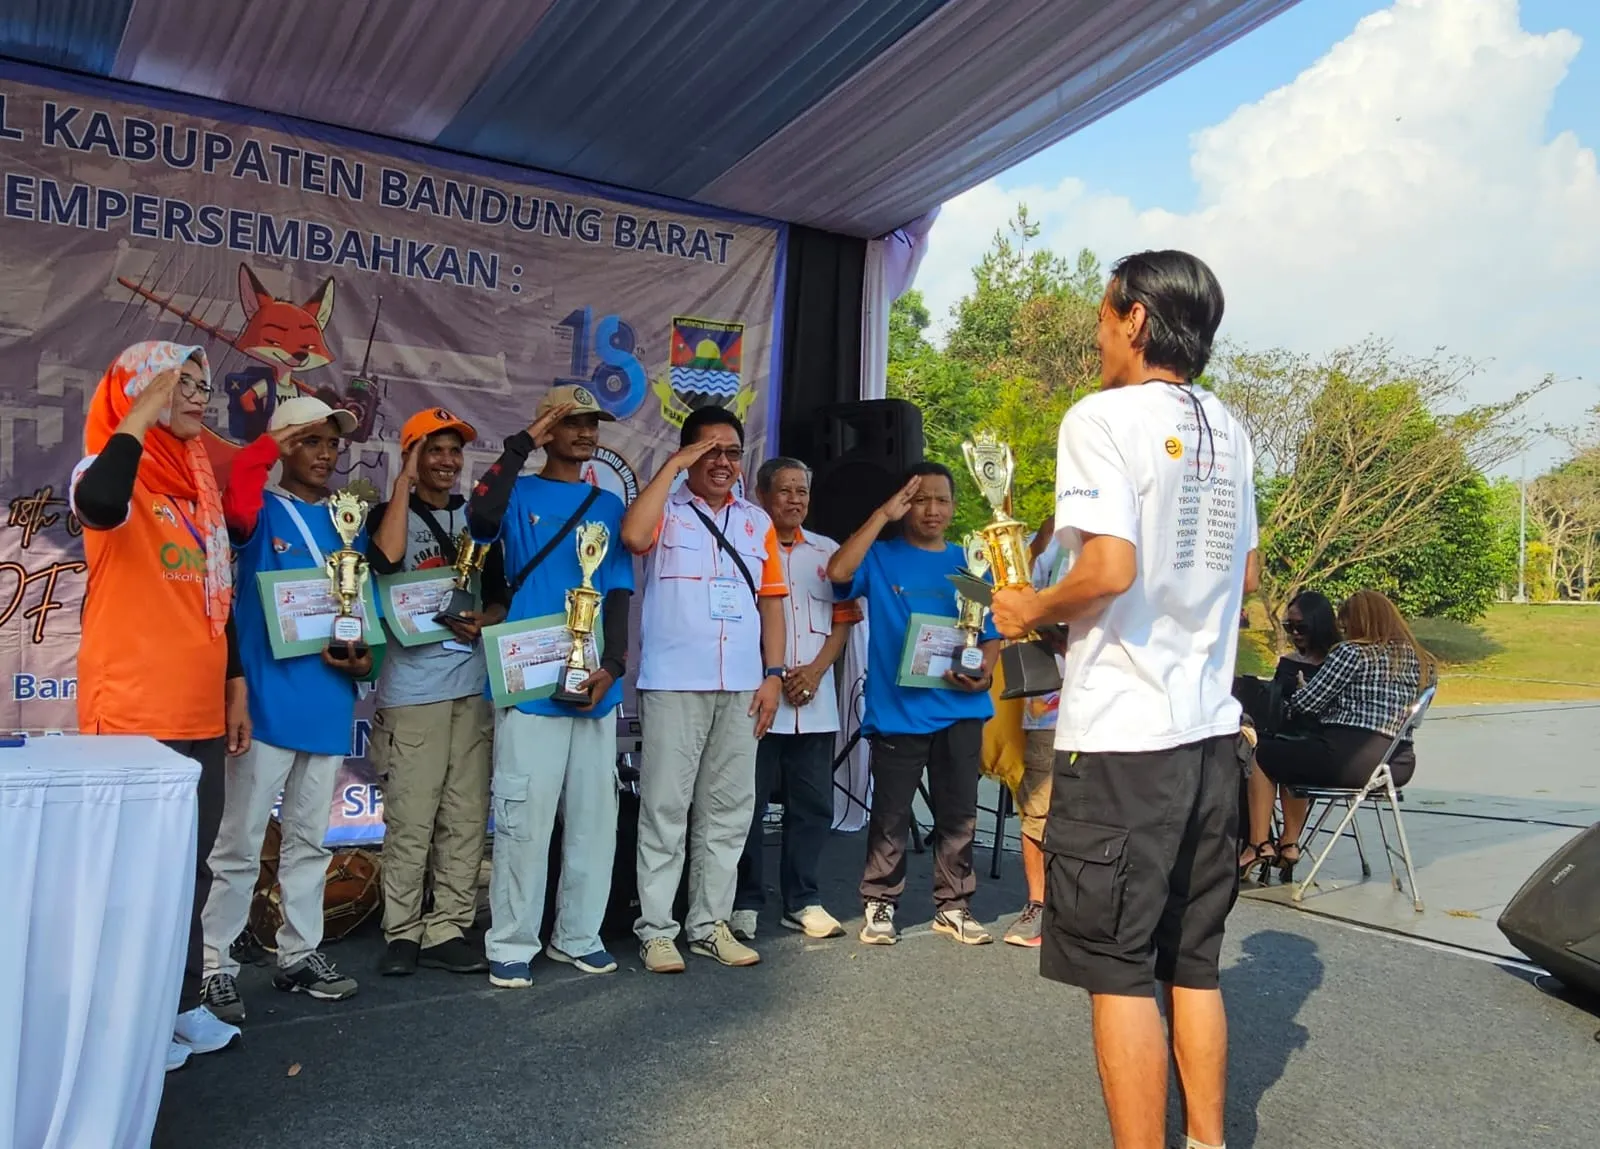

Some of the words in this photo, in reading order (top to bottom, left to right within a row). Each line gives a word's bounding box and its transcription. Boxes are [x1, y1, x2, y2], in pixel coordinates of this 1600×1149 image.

[3, 172, 499, 291] EMPERSEMBAHKAN
[42, 100, 366, 202] KABUPATEN
[380, 167, 603, 243] BANDUNG
[613, 213, 735, 265] BARAT
[596, 448, 623, 470] RADIO
